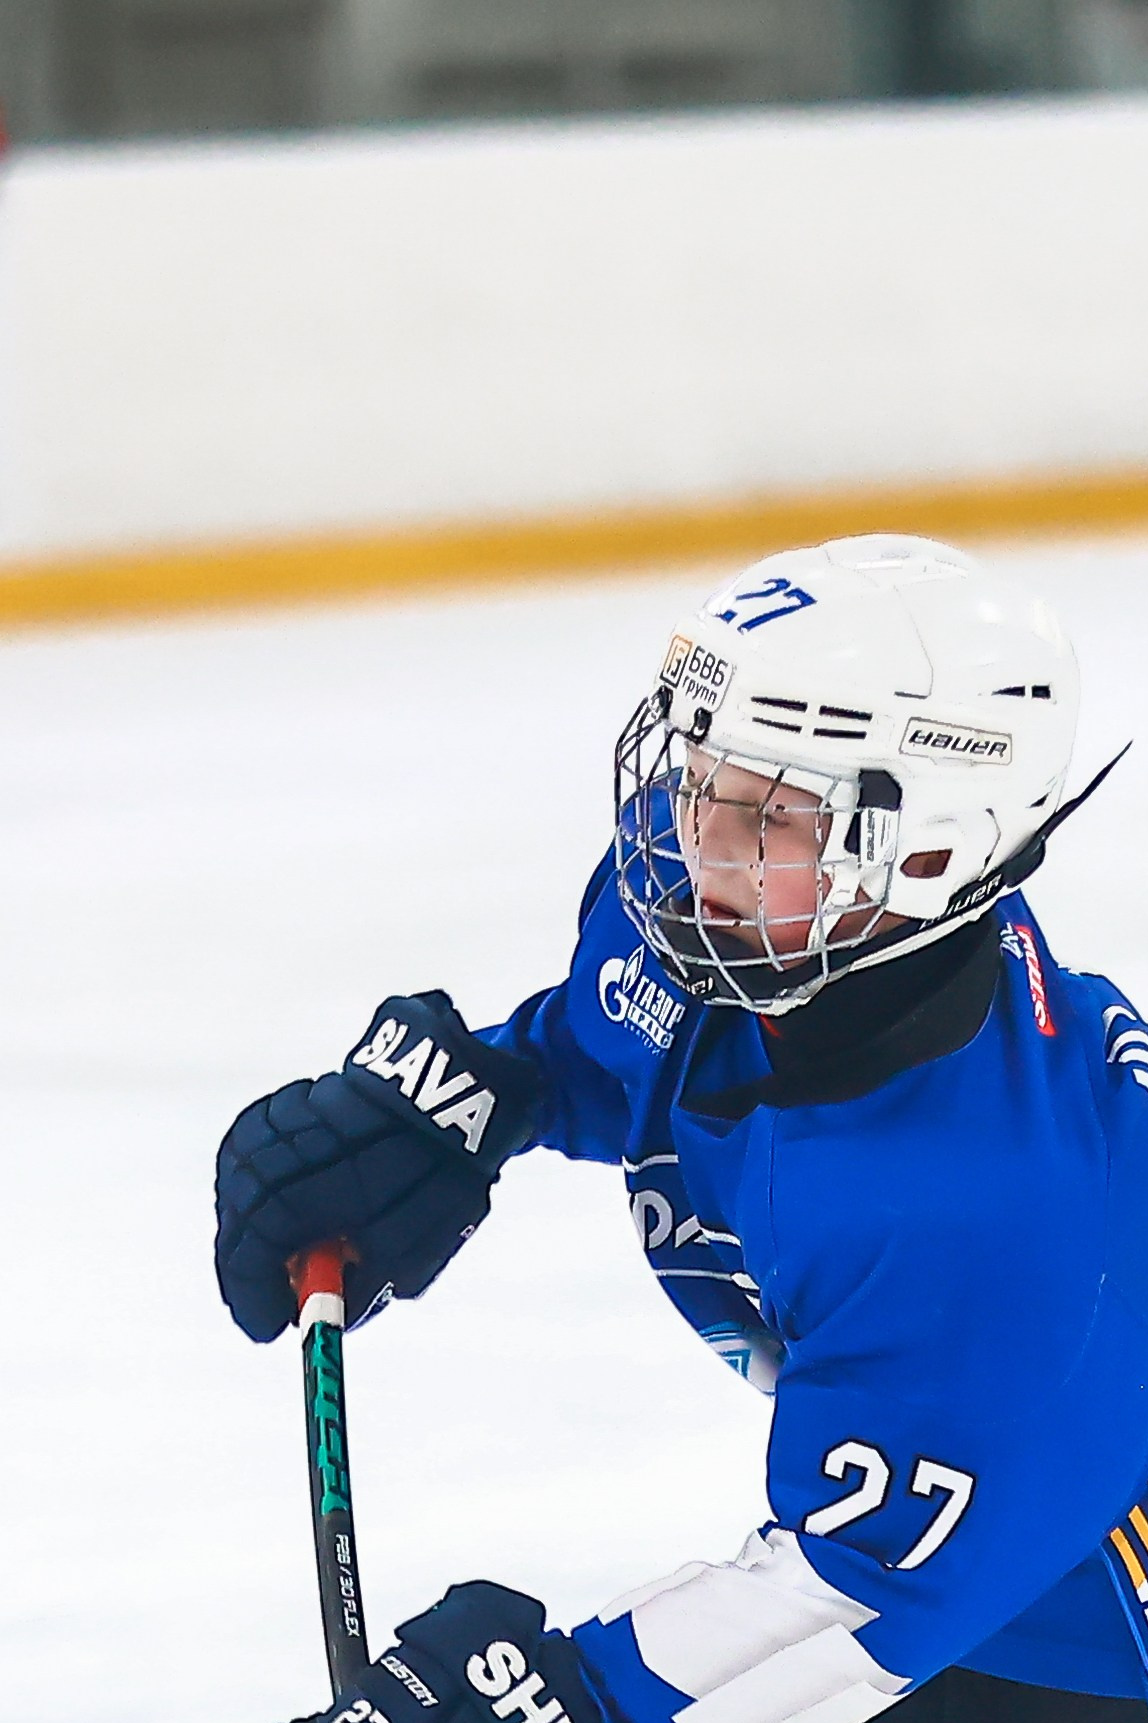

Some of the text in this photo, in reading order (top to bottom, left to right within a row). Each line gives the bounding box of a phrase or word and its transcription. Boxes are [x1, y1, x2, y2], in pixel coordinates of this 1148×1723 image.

[714, 578, 817, 635] 27
[681, 674, 718, 706] групп
[688, 645, 729, 687] БВБ
[352, 1018, 496, 1154] SLAVA
[804, 1440, 975, 1570] 27
